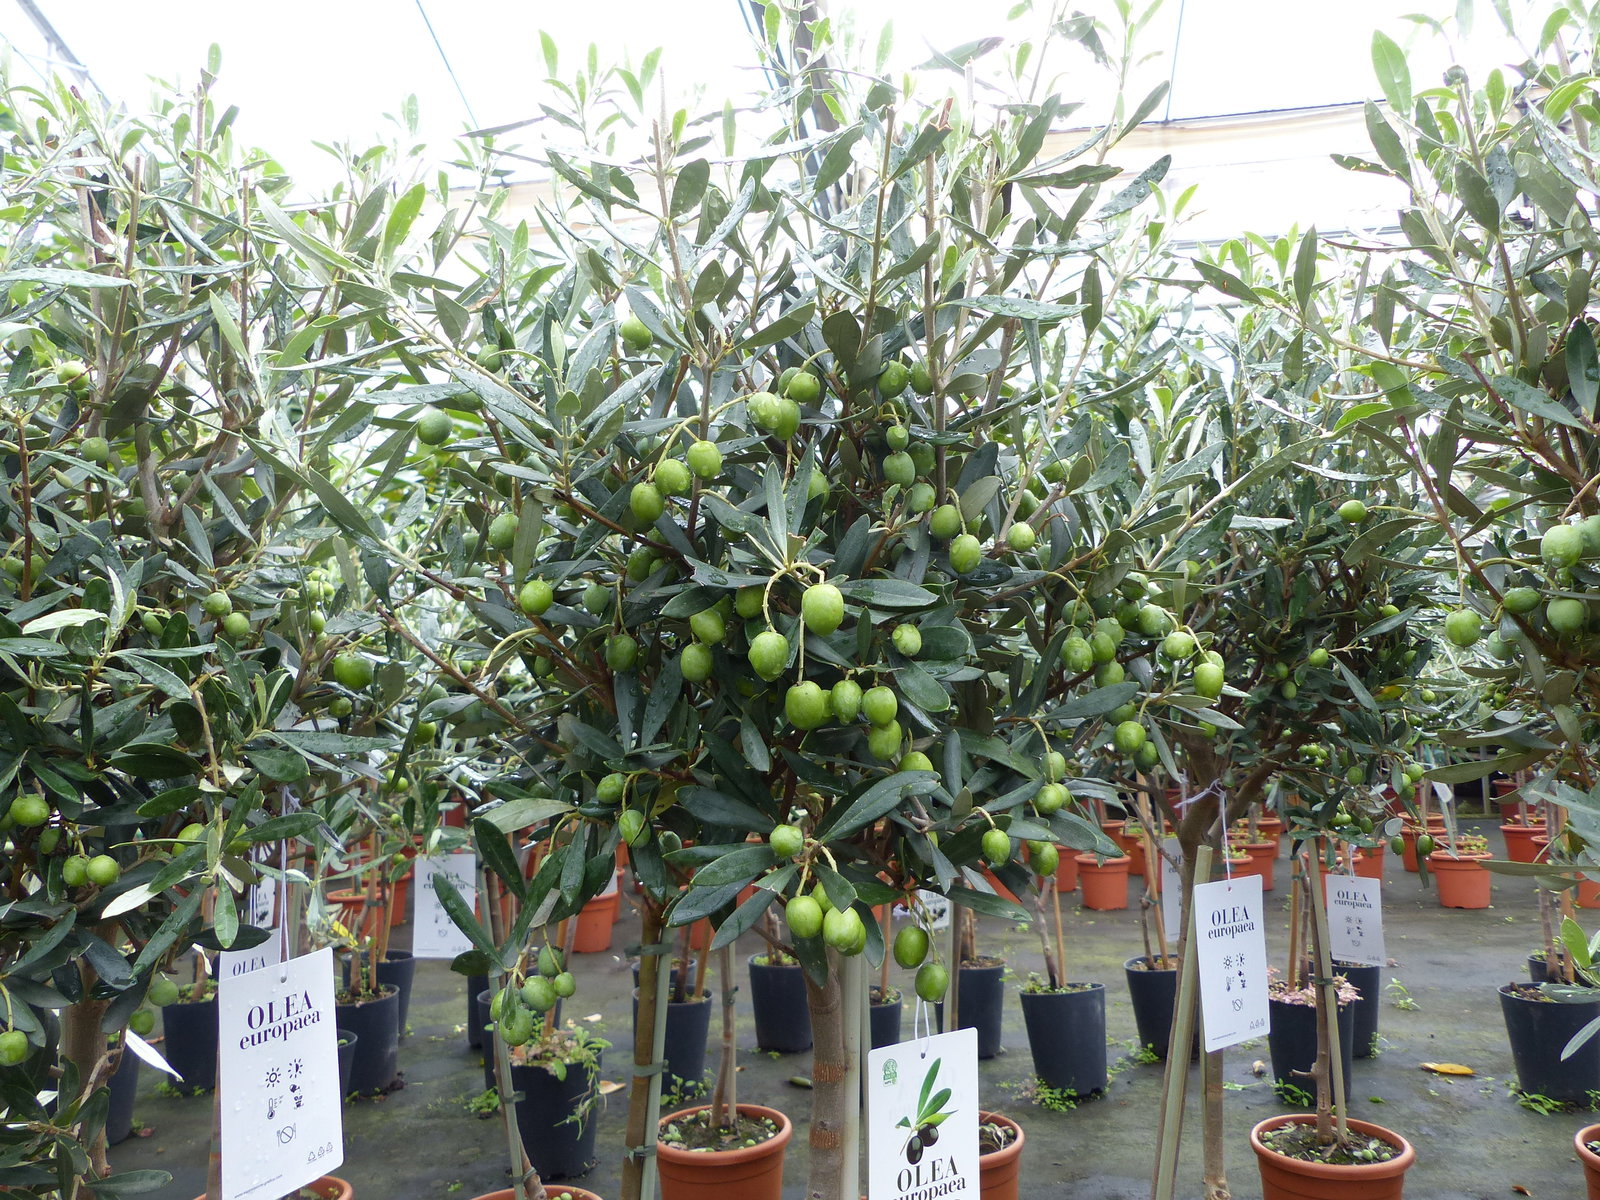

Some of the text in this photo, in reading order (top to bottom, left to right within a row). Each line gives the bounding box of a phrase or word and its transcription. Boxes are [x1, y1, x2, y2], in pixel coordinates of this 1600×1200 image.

[1334, 899, 1372, 909] europaea
[1337, 890, 1368, 901] OLEA
[1211, 905, 1249, 926] OLEA
[1208, 922, 1255, 939] europaea
[233, 956, 265, 976] OLEA
[247, 990, 313, 1030] OLEA
[240, 1010, 320, 1050] europaea
[897, 1155, 959, 1192] OLEA
